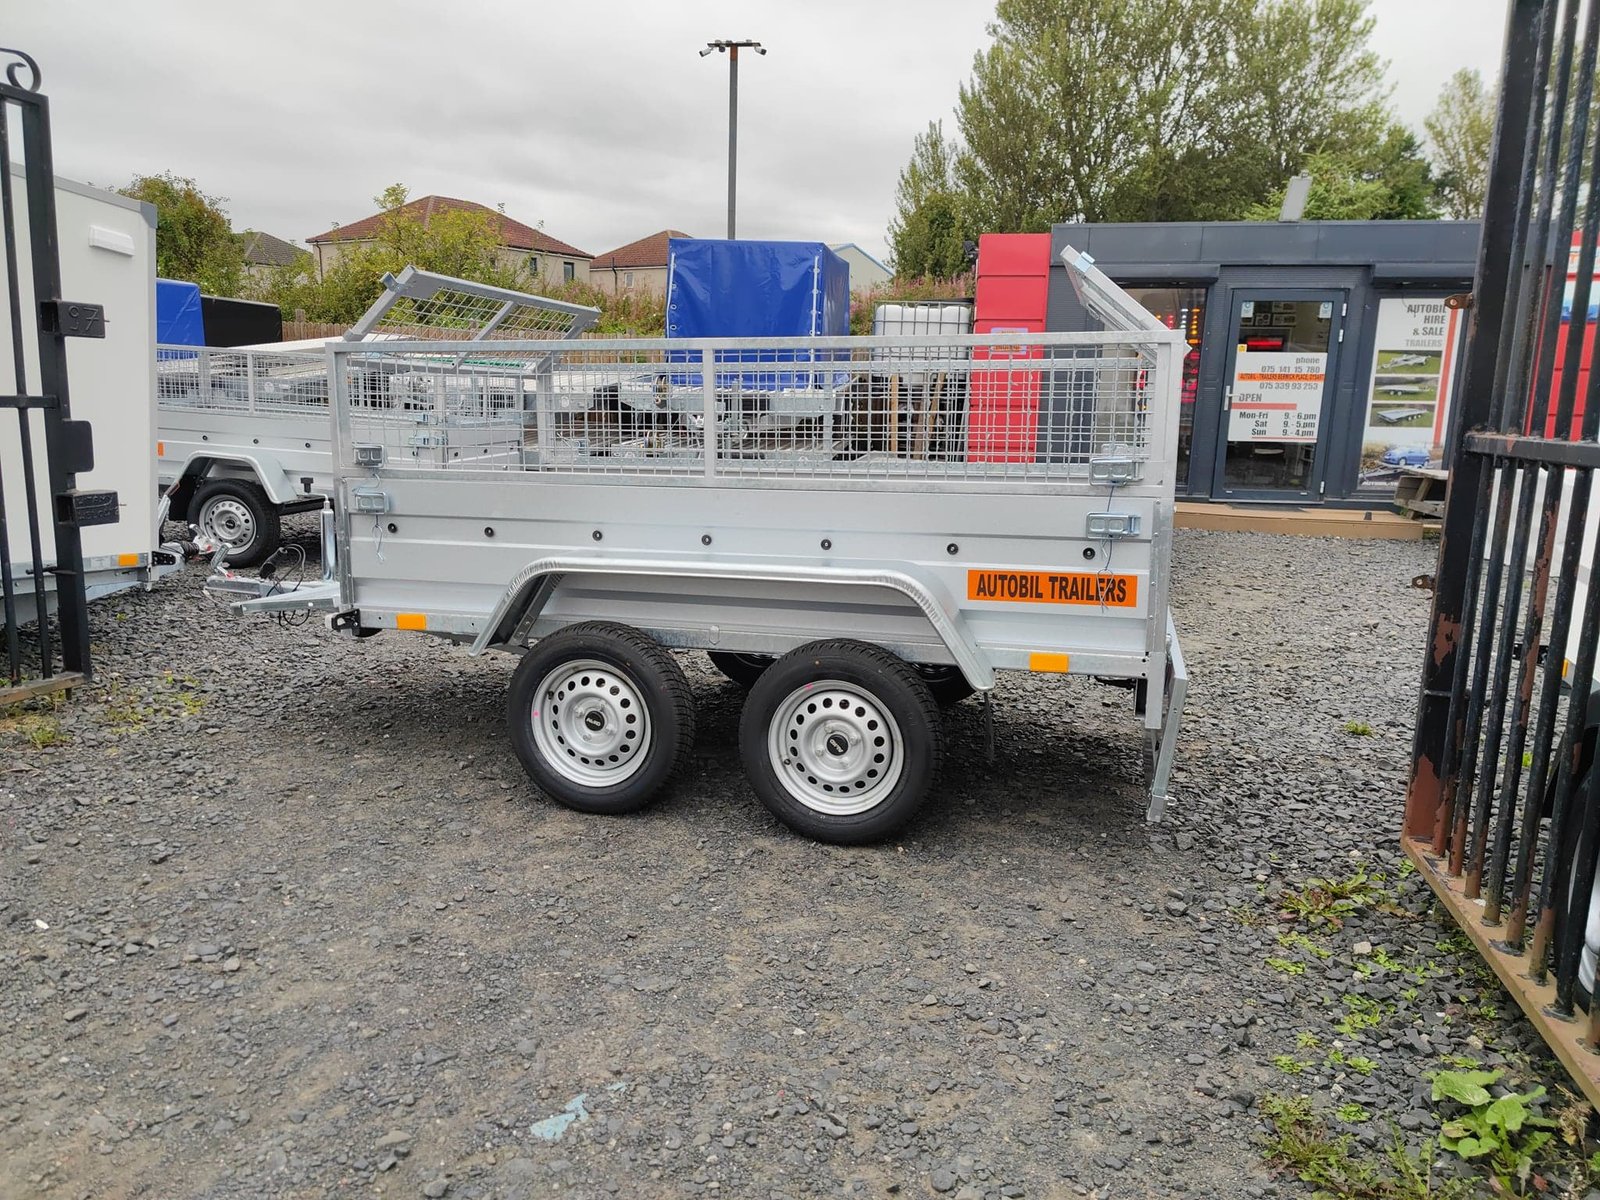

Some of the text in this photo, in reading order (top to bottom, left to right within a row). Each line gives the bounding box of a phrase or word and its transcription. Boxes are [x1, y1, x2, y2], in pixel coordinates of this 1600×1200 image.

[1407, 304, 1446, 313] AUTOBIL
[1423, 315, 1445, 324] HIRE
[1412, 327, 1444, 336] & SALE
[1406, 339, 1443, 347] TRAILERS
[1239, 393, 1262, 402] OPEN
[1239, 411, 1268, 419] Mon-Fri
[1254, 420, 1267, 428] Sat
[976, 573, 1126, 603] AUTOBIL TRAILERS
